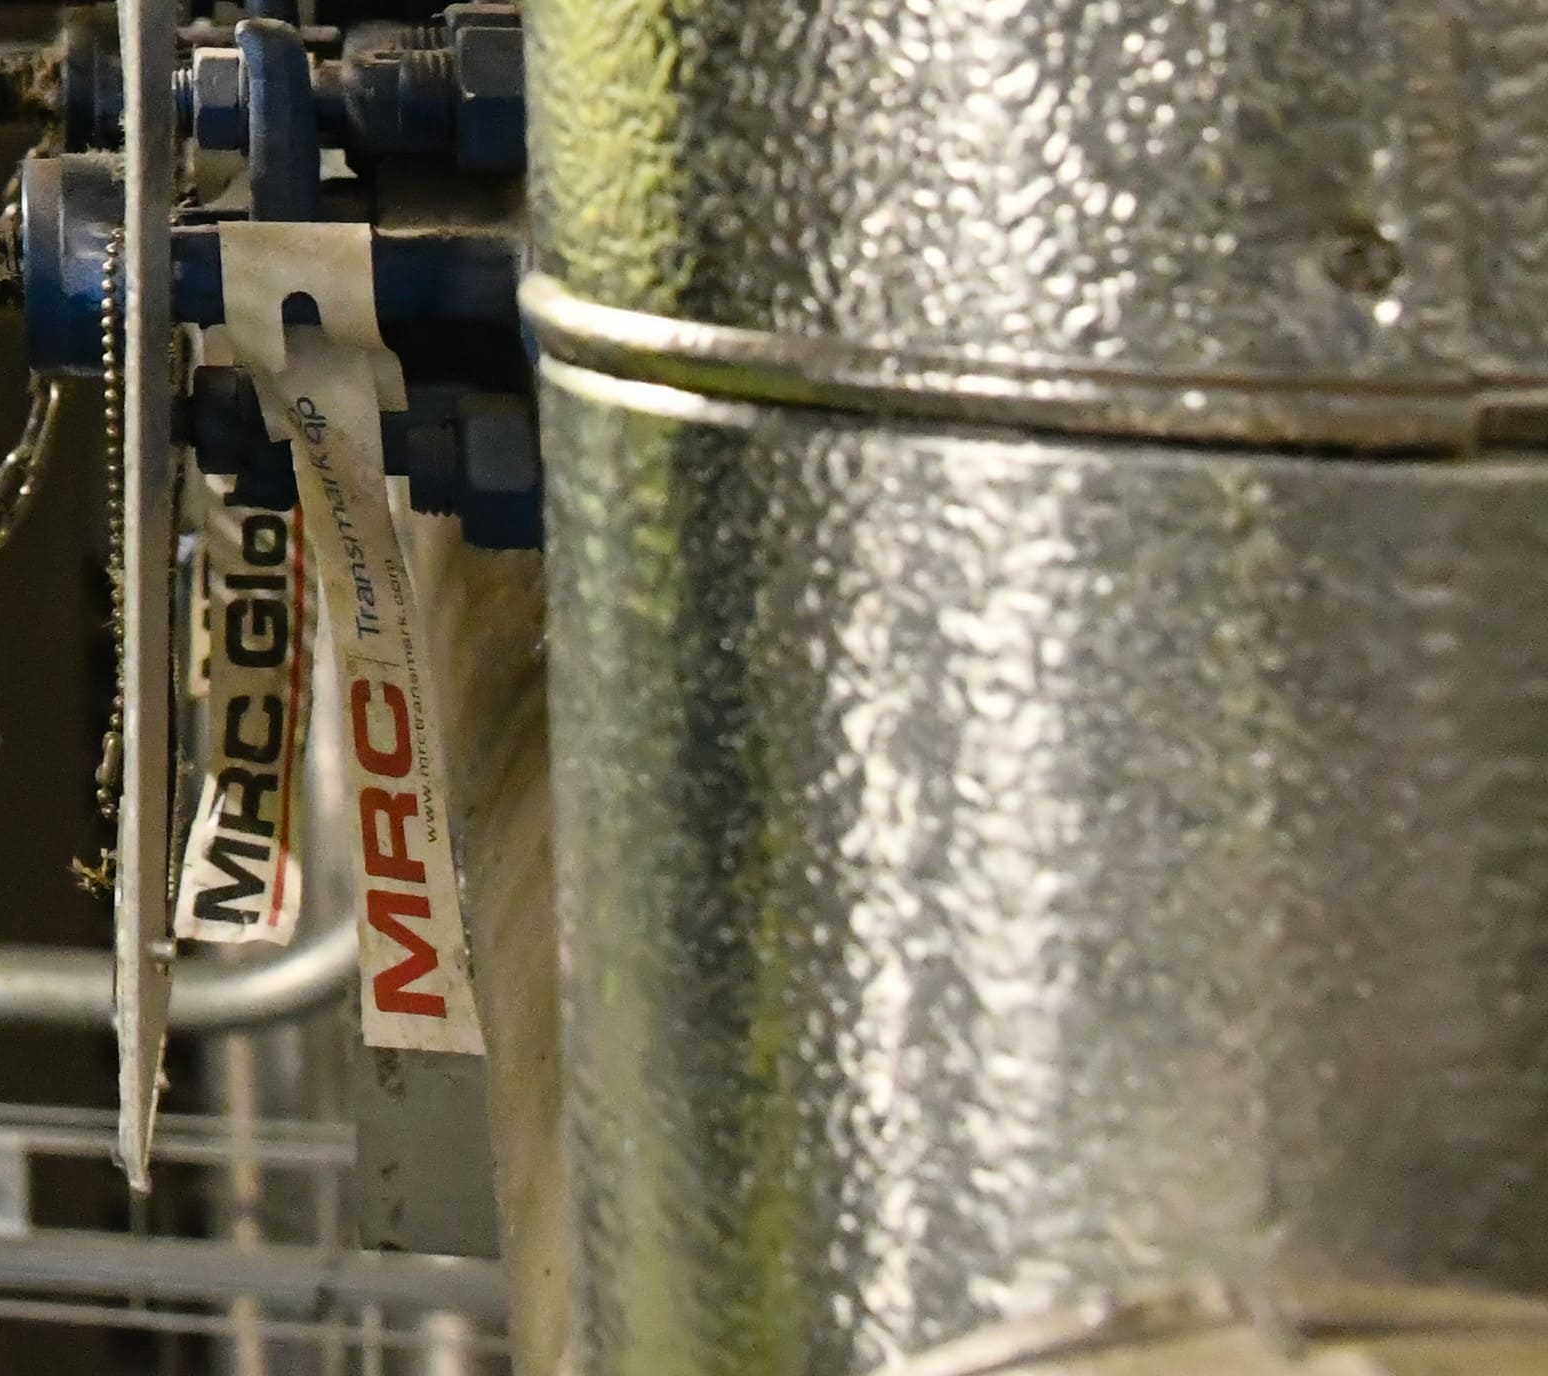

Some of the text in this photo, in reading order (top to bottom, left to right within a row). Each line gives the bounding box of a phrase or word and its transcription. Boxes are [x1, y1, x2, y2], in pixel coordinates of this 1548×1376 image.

[193, 494, 292, 924] MRC Glo
[311, 454, 447, 1017] MRC Transmark
[381, 559, 438, 843] www.mrctransmark.com
